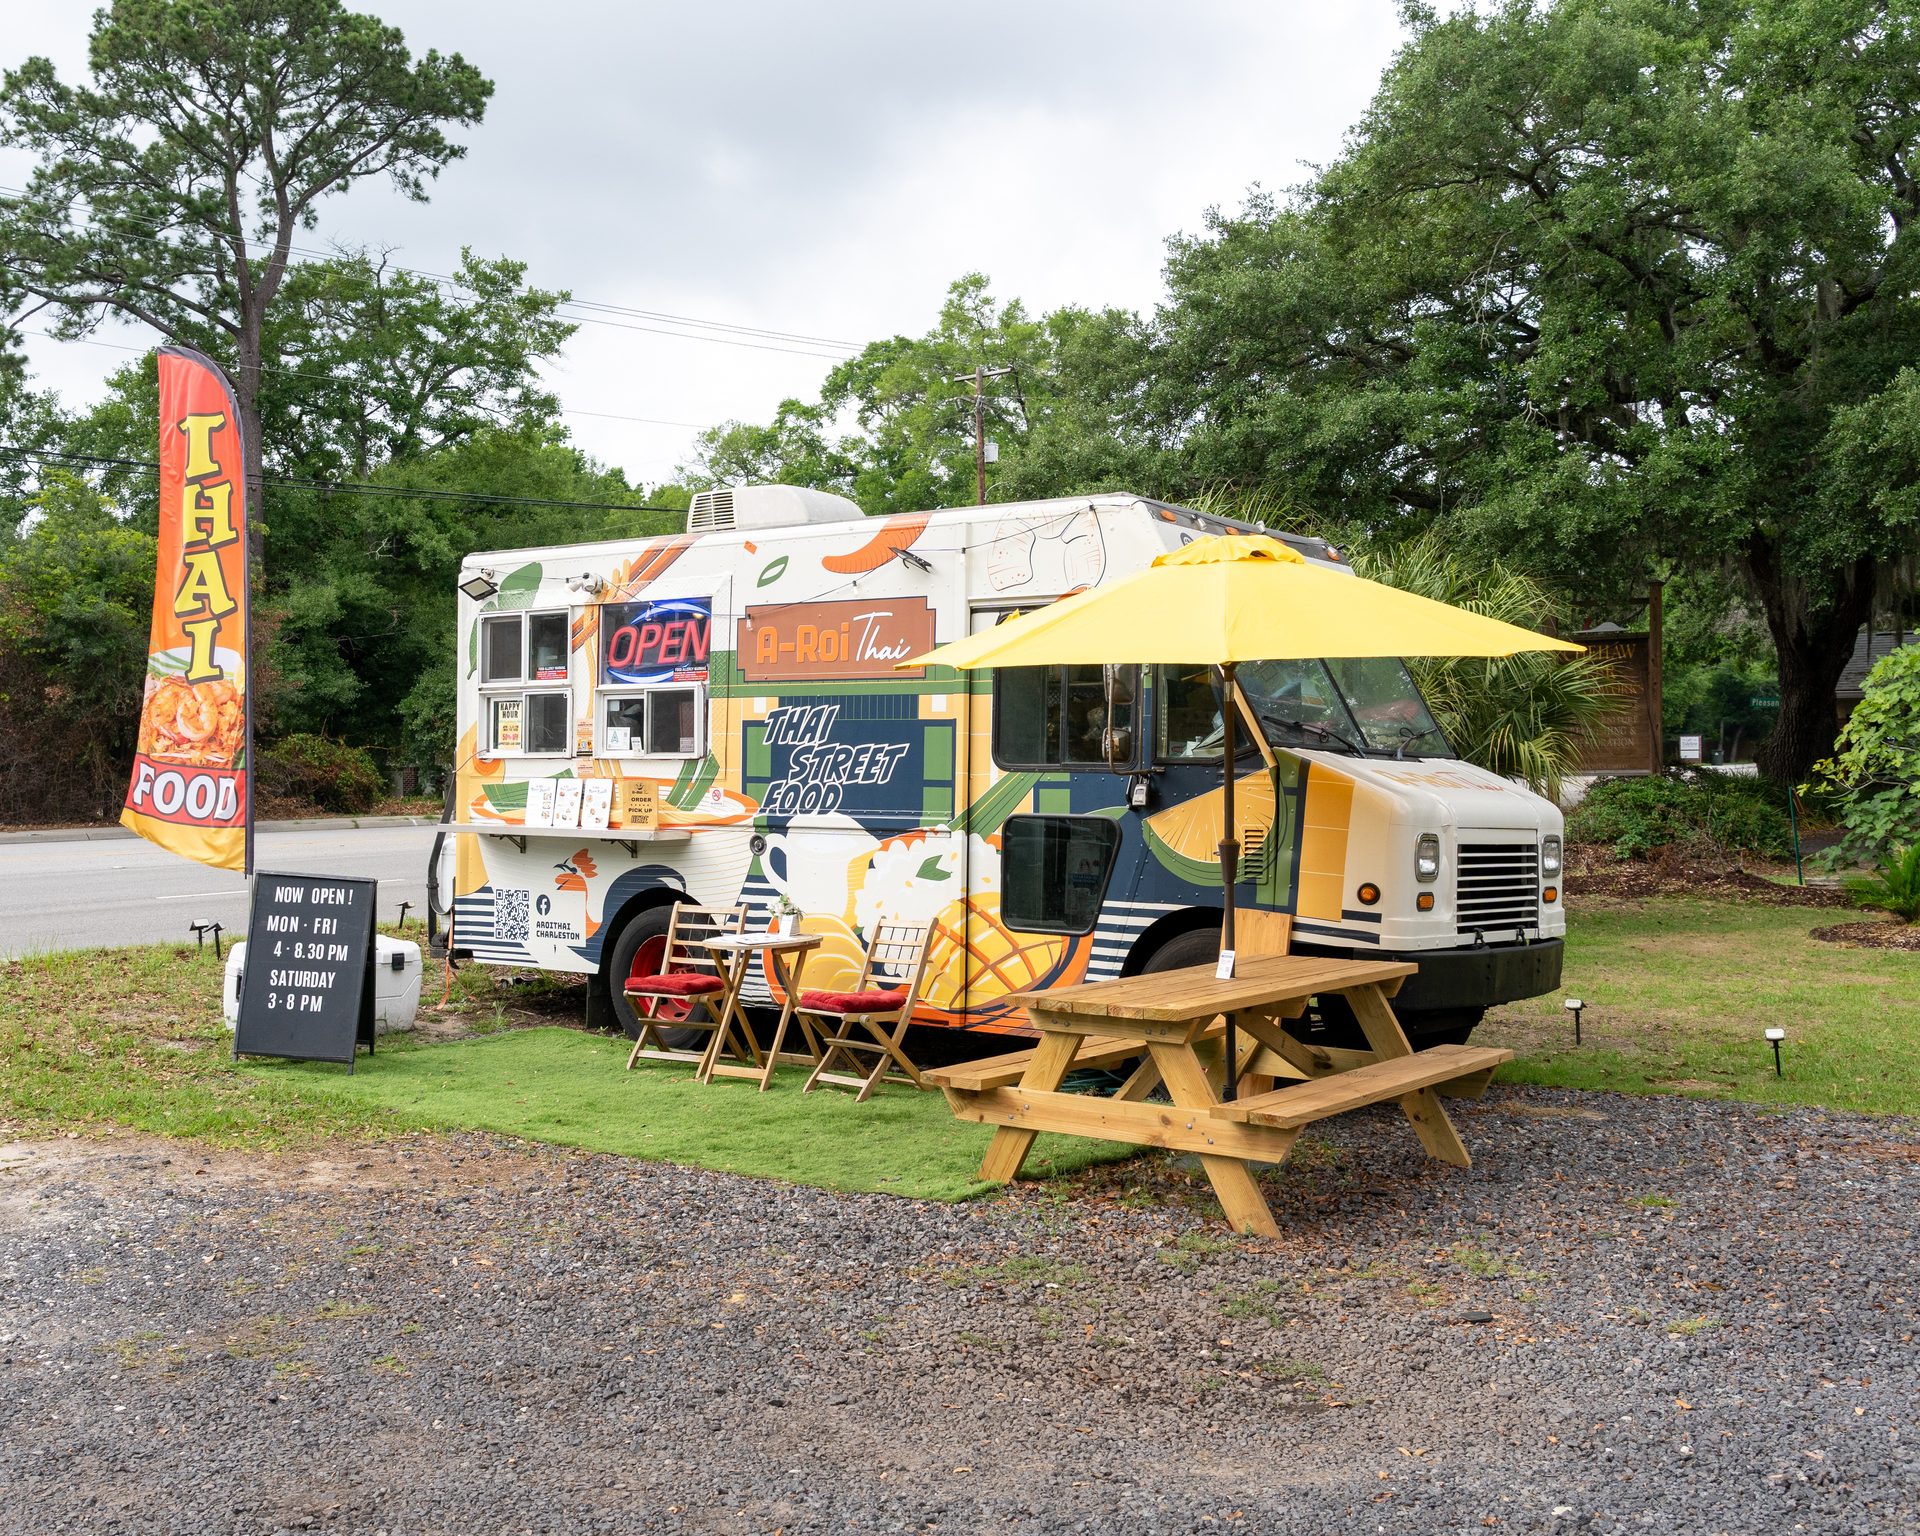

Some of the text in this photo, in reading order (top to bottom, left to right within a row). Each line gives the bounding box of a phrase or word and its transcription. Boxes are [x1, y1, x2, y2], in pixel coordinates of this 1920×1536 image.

[608, 618, 711, 669] OPEN
[853, 611, 911, 662] Thai
[500, 702, 520, 711] HAPPY
[1752, 698, 1780, 706] Pleasan
[502, 710, 518, 719] HOUR
[762, 704, 841, 745] THAI
[787, 742, 911, 785] STREET
[133, 761, 239, 822] FOOD
[758, 780, 843, 817] FOOD
[274, 886, 304, 904] NOW
[267, 915, 299, 933] MON
[313, 917, 338, 935] FRI
[536, 921, 571, 931] AROITHAI
[536, 930, 580, 940] CHARLESTON
[327, 944, 348, 961] PM
[269, 969, 336, 989] SATURDAY
[300, 995, 323, 1013] PM
